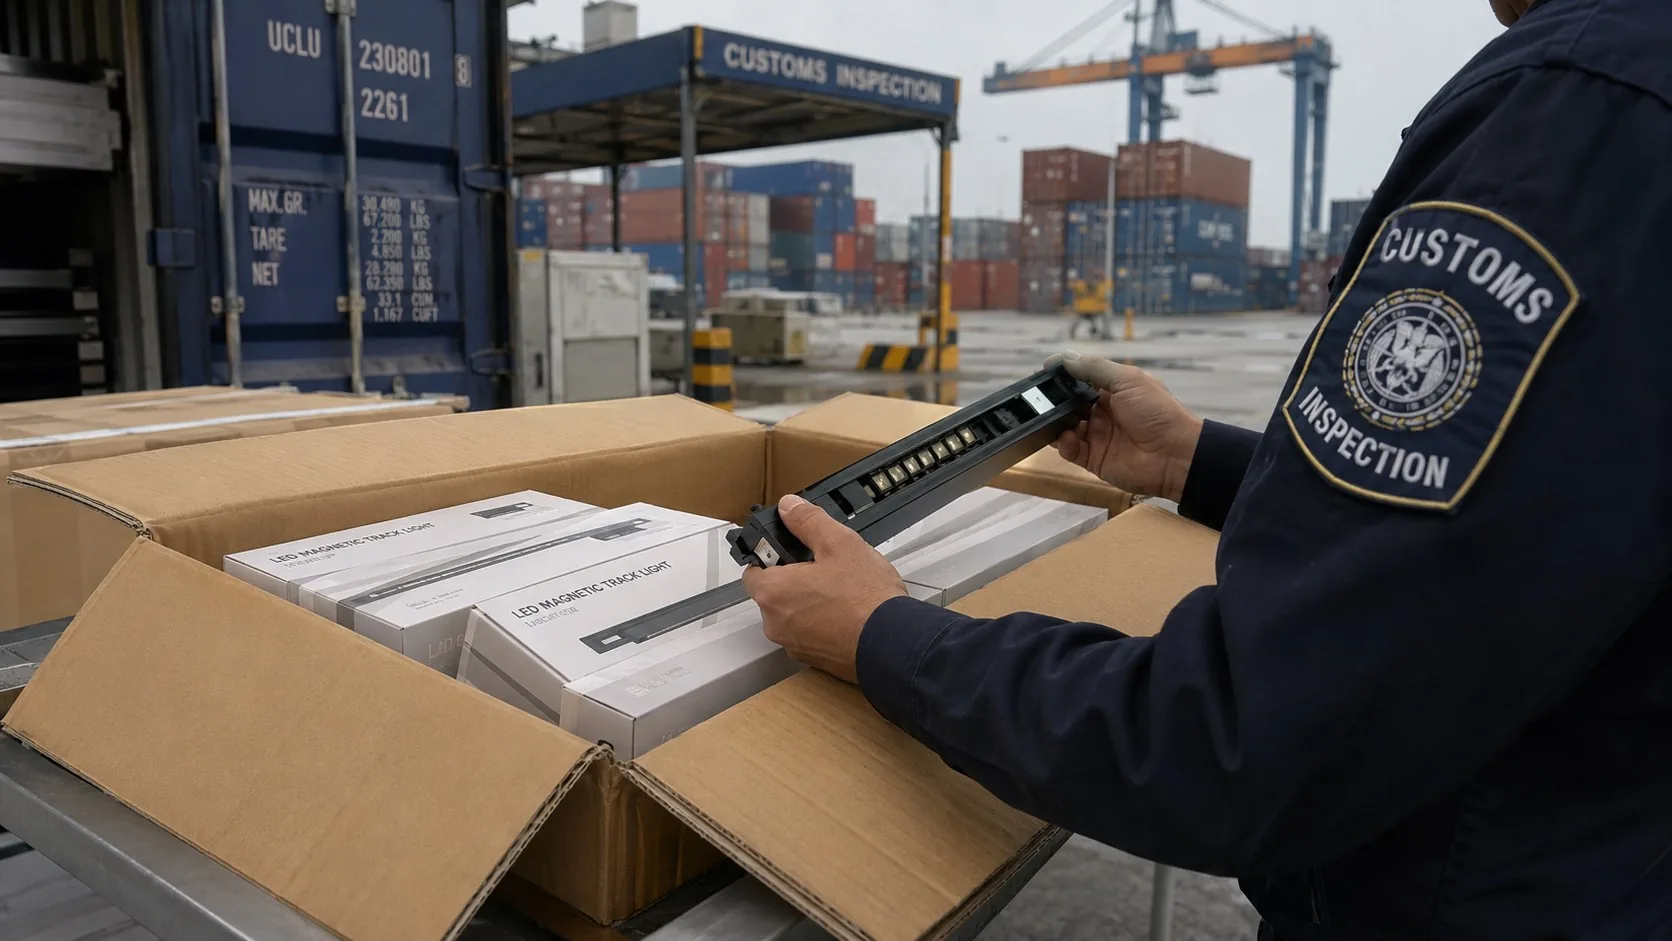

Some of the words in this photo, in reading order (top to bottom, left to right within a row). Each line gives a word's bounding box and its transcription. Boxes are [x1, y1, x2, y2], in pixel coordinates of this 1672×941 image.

[267, 19, 321, 58] UCLU
[359, 39, 431, 80] 230801
[724, 42, 828, 85] CUSTOMS
[836, 63, 942, 105] INSPECTION
[361, 88, 408, 122] 2261
[250, 226, 287, 252] TARE
[252, 262, 280, 286] NET
[1380, 227, 1554, 324] CUSTOMS
[1298, 386, 1450, 489] INSPECTION
[269, 553, 298, 564] LED
[298, 539, 365, 558] MAGNETIC
[361, 529, 404, 542] TRACK
[402, 522, 435, 533] LIGHT
[511, 605, 540, 619] LED
[538, 584, 604, 610] MAGNETIC
[600, 571, 642, 588] TRACK
[638, 560, 672, 576] LIGHT
